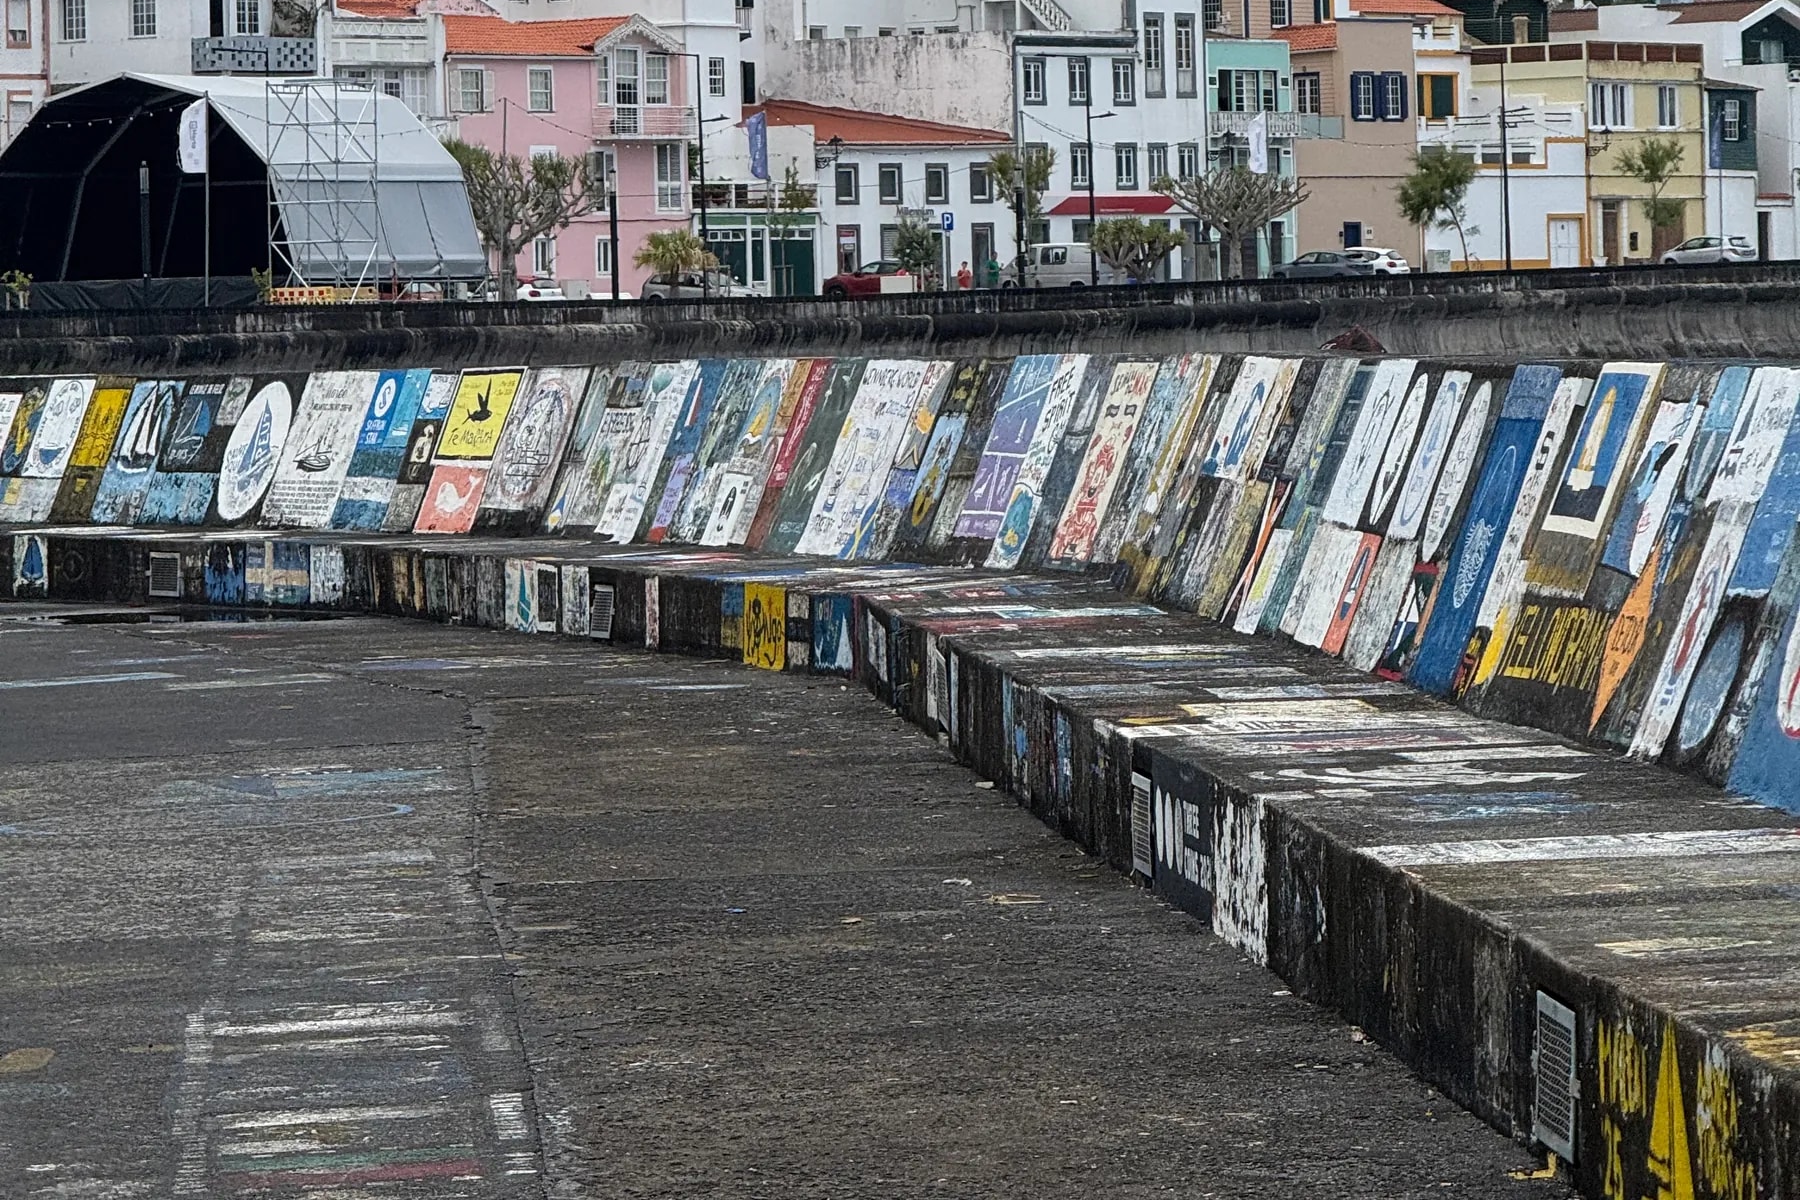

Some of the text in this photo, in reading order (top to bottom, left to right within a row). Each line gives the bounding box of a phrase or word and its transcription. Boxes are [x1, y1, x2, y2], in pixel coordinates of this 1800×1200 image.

[943, 213, 952, 229] P
[1048, 365, 1076, 404] FREE
[1042, 390, 1076, 432] SPIRIT
